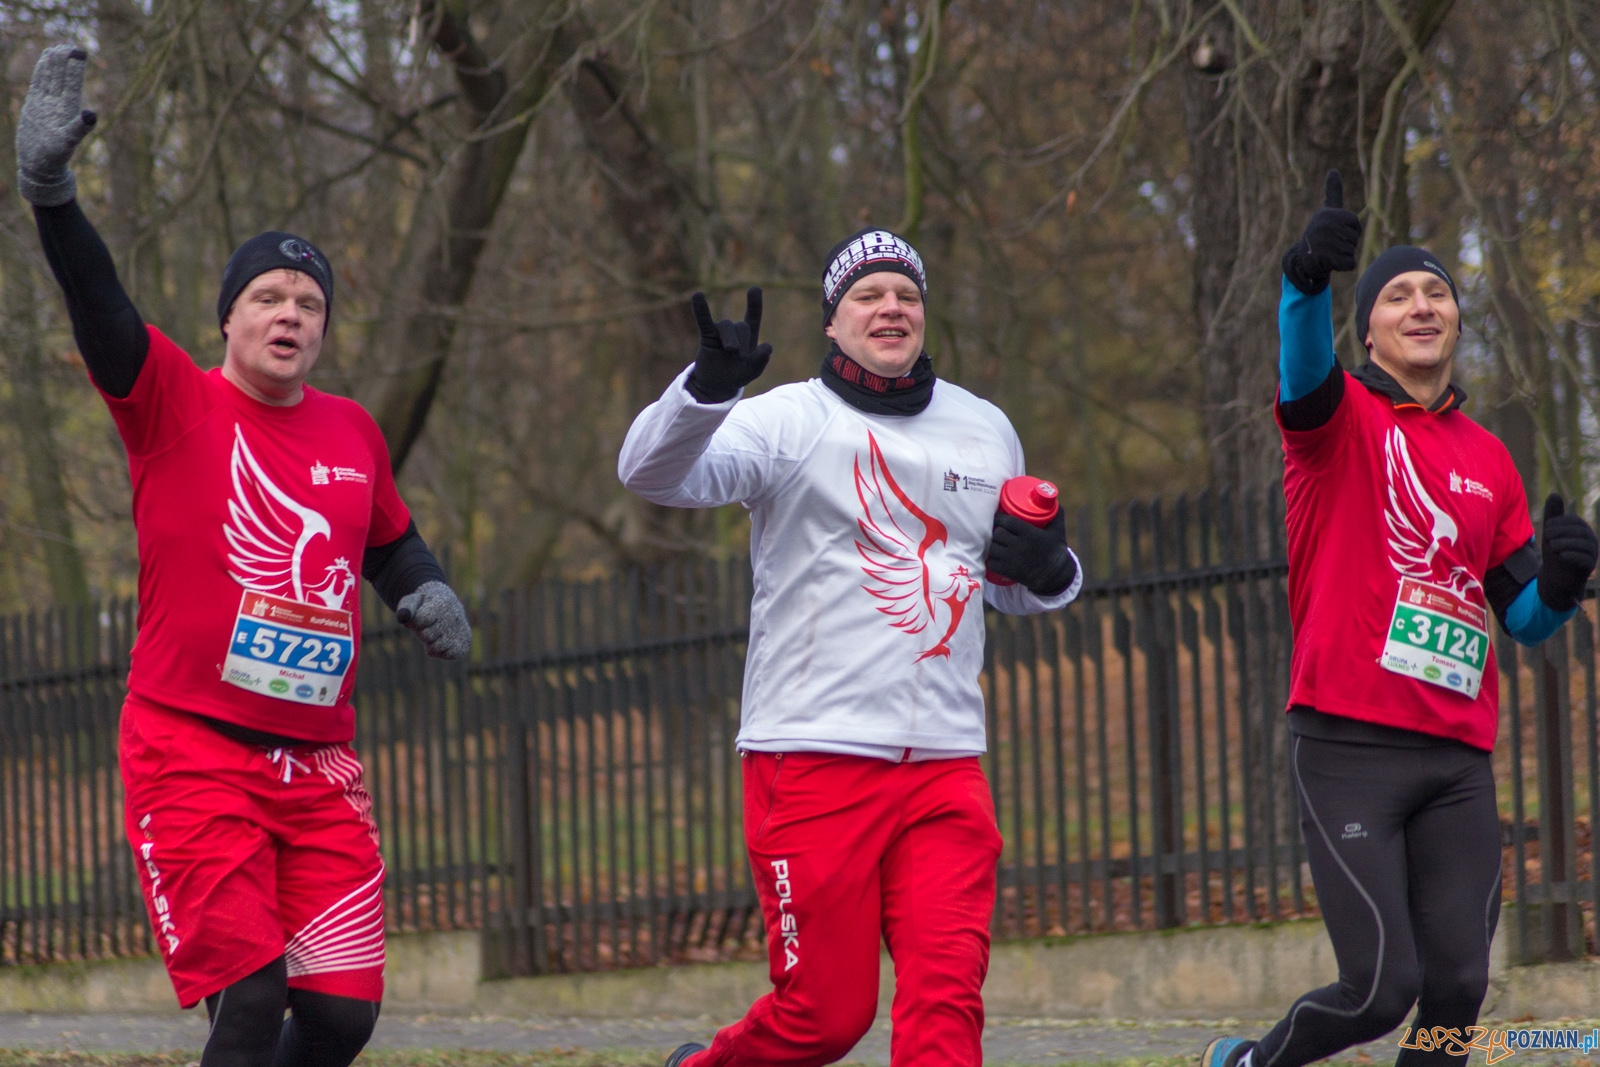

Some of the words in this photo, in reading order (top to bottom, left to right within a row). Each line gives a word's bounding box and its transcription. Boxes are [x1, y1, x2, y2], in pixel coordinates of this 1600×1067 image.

[237, 632, 248, 644] E
[250, 628, 341, 672] 5723
[1408, 615, 1479, 664] 3124
[1431, 655, 1457, 670] Tomasz
[770, 859, 800, 972] POLSKA
